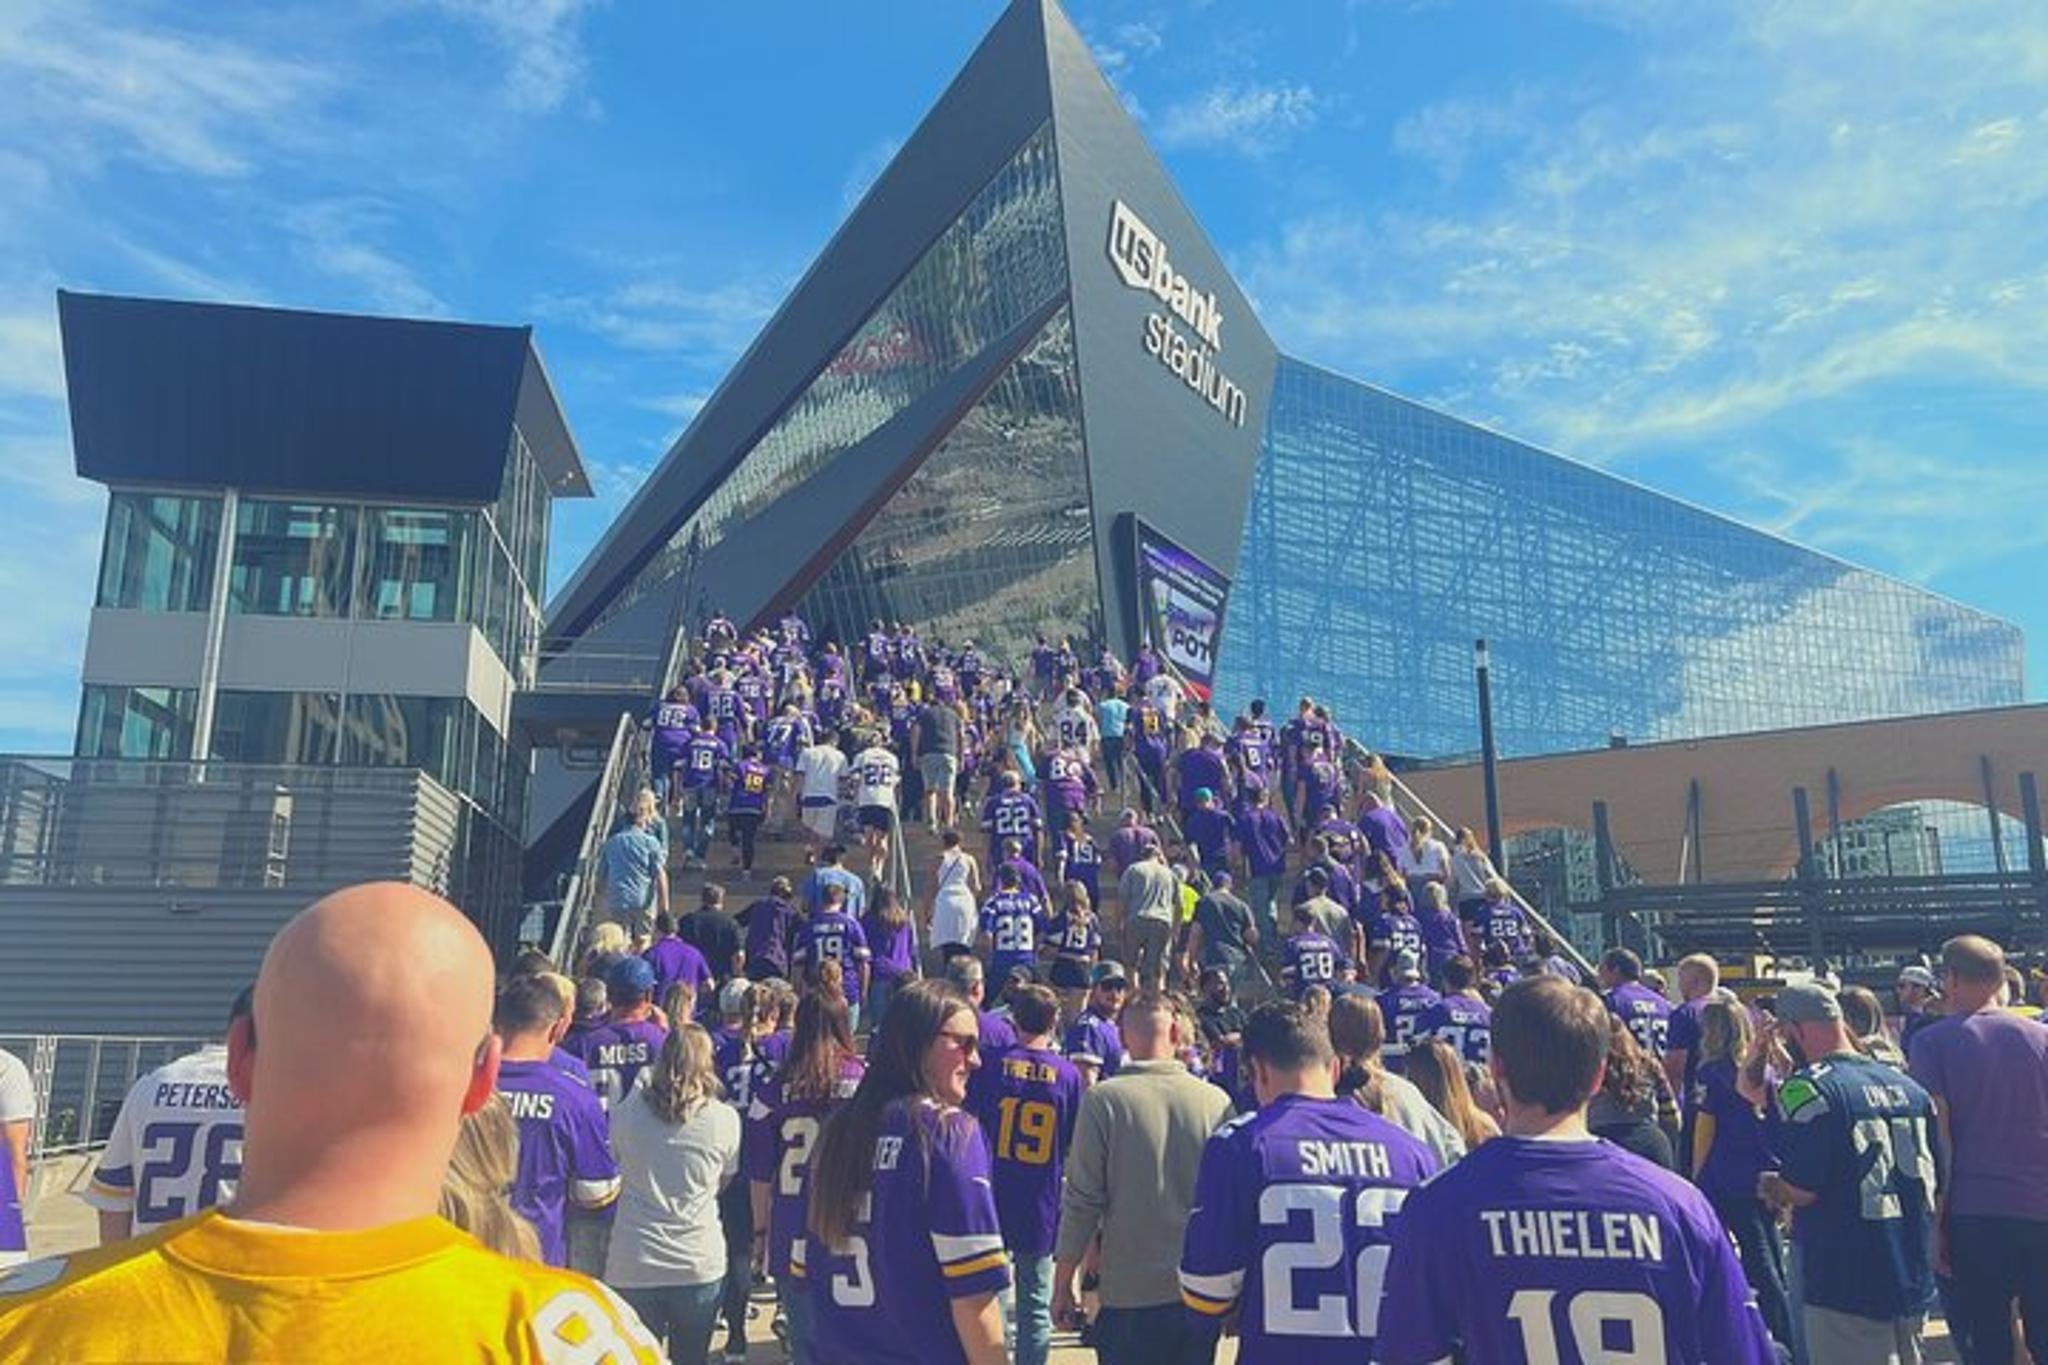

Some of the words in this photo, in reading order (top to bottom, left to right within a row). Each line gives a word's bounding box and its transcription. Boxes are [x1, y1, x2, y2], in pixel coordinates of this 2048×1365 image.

[1152, 241, 1224, 351] bank
[1145, 312, 1248, 428] stadium
[994, 806, 1031, 834] 22
[1300, 951, 1333, 980] 28
[599, 1042, 648, 1064] MOSS
[998, 1097, 1056, 1165] 19
[1298, 1141, 1391, 1178] SMITH
[1480, 1210, 1662, 1262] THIELEN
